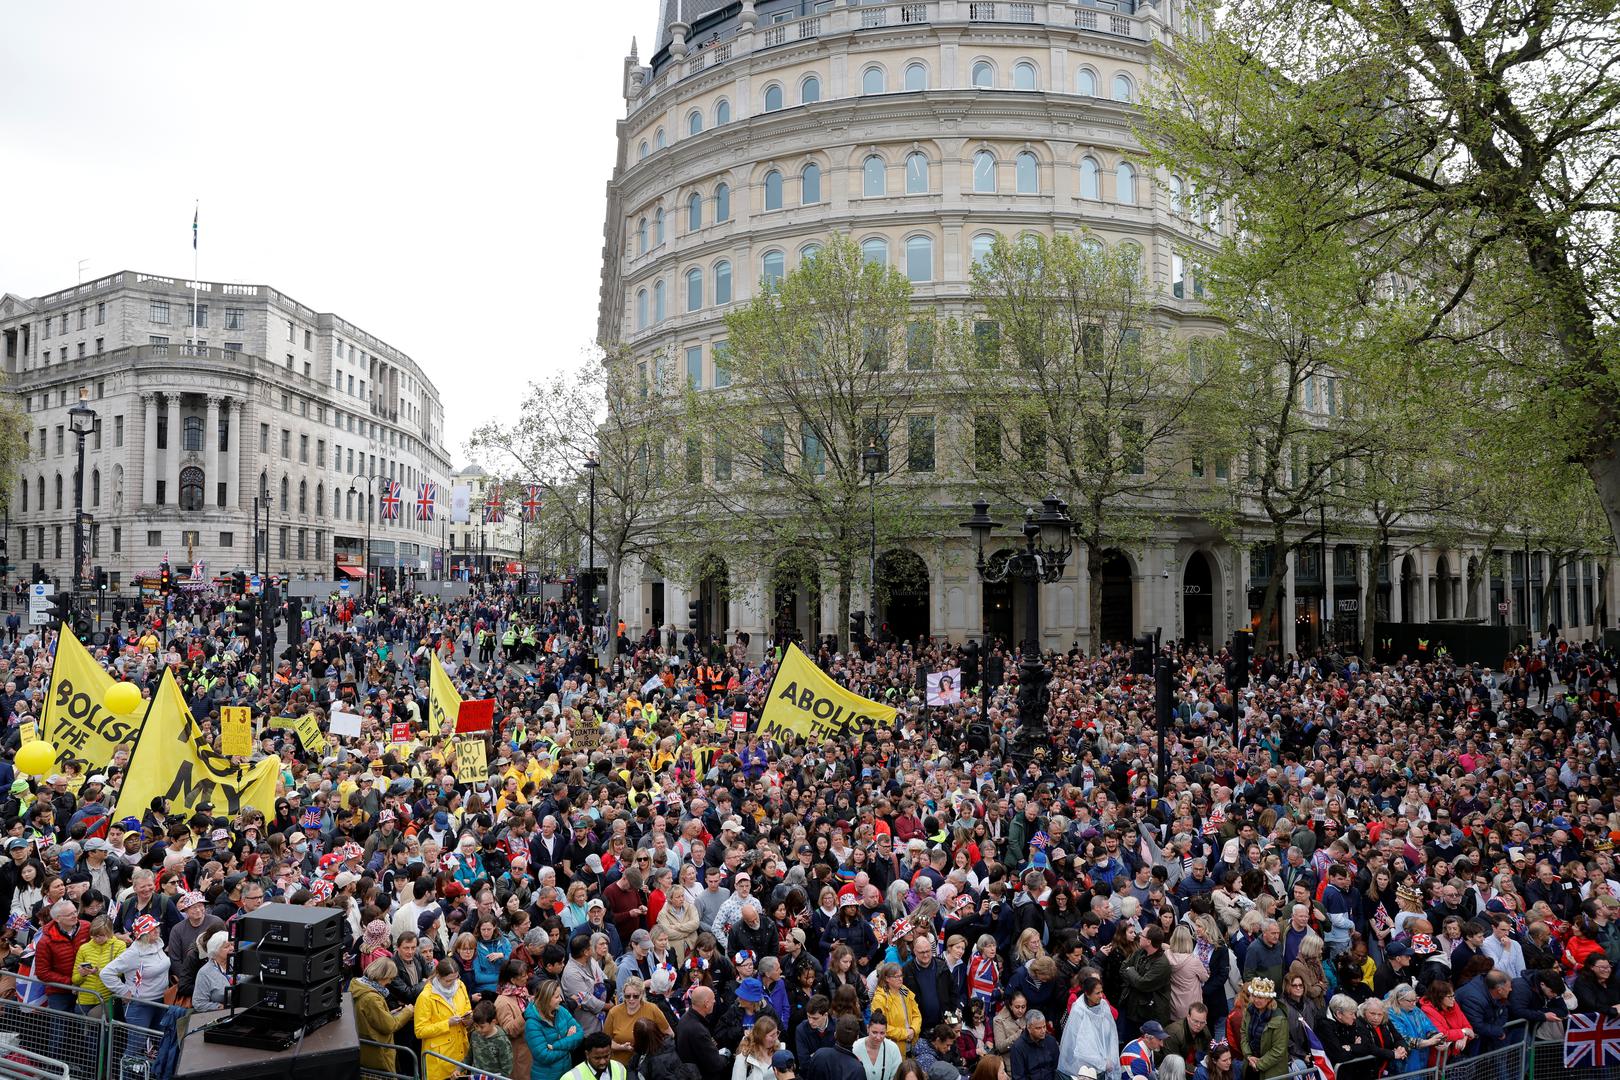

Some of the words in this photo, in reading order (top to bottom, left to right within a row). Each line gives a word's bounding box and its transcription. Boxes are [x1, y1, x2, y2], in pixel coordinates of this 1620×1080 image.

[1338, 599, 1358, 612] PREZZO
[53, 717, 90, 751] THE
[456, 741, 483, 758] NOT
[461, 756, 479, 766] MY
[165, 760, 257, 816] MY
